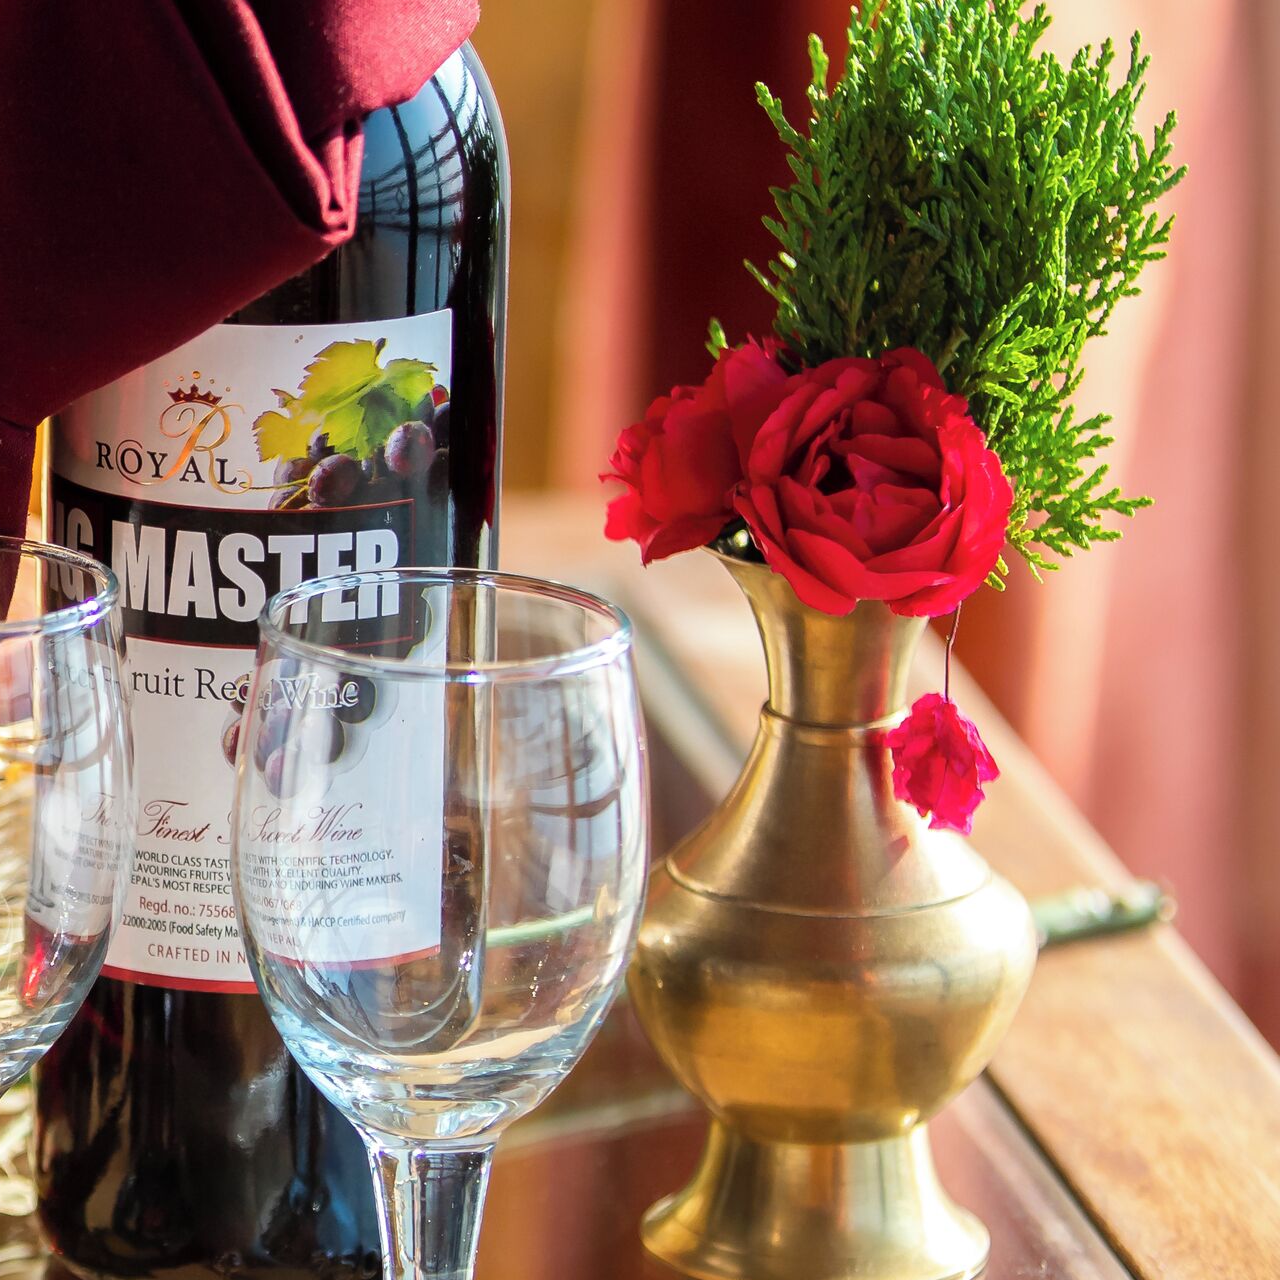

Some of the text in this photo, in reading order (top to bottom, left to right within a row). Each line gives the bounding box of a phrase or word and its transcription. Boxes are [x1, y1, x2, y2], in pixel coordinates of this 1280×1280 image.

[96, 441, 238, 485] ROYAL
[50, 501, 401, 625] IG MASTER
[280, 673, 360, 711] Wine
[138, 800, 210, 843] Finest
[308, 802, 363, 842] Wine
[135, 849, 170, 865] WORLD
[171, 855, 202, 868] CLASS
[258, 855, 277, 867] WITH
[280, 855, 327, 867] SCIENTIFIC
[330, 849, 394, 867] TECHNOLOGY.
[131, 862, 187, 879] LAVOURING
[189, 870, 224, 882] FRUITS
[321, 866, 364, 878] QUALITY.
[131, 874, 160, 889] EPAL'S
[162, 880, 189, 893] MOST
[289, 878, 338, 891] ENDURING
[340, 878, 365, 889] WINE
[366, 873, 403, 886] MAKERS.
[139, 896, 171, 916] Regd.
[169, 922, 194, 936] (Food
[195, 924, 223, 940] Safety
[308, 915, 336, 928] HACCP
[337, 914, 370, 928] Certified
[372, 910, 406, 925] company
[148, 943, 210, 963] CRAFTED
[216, 950, 231, 964] IN
